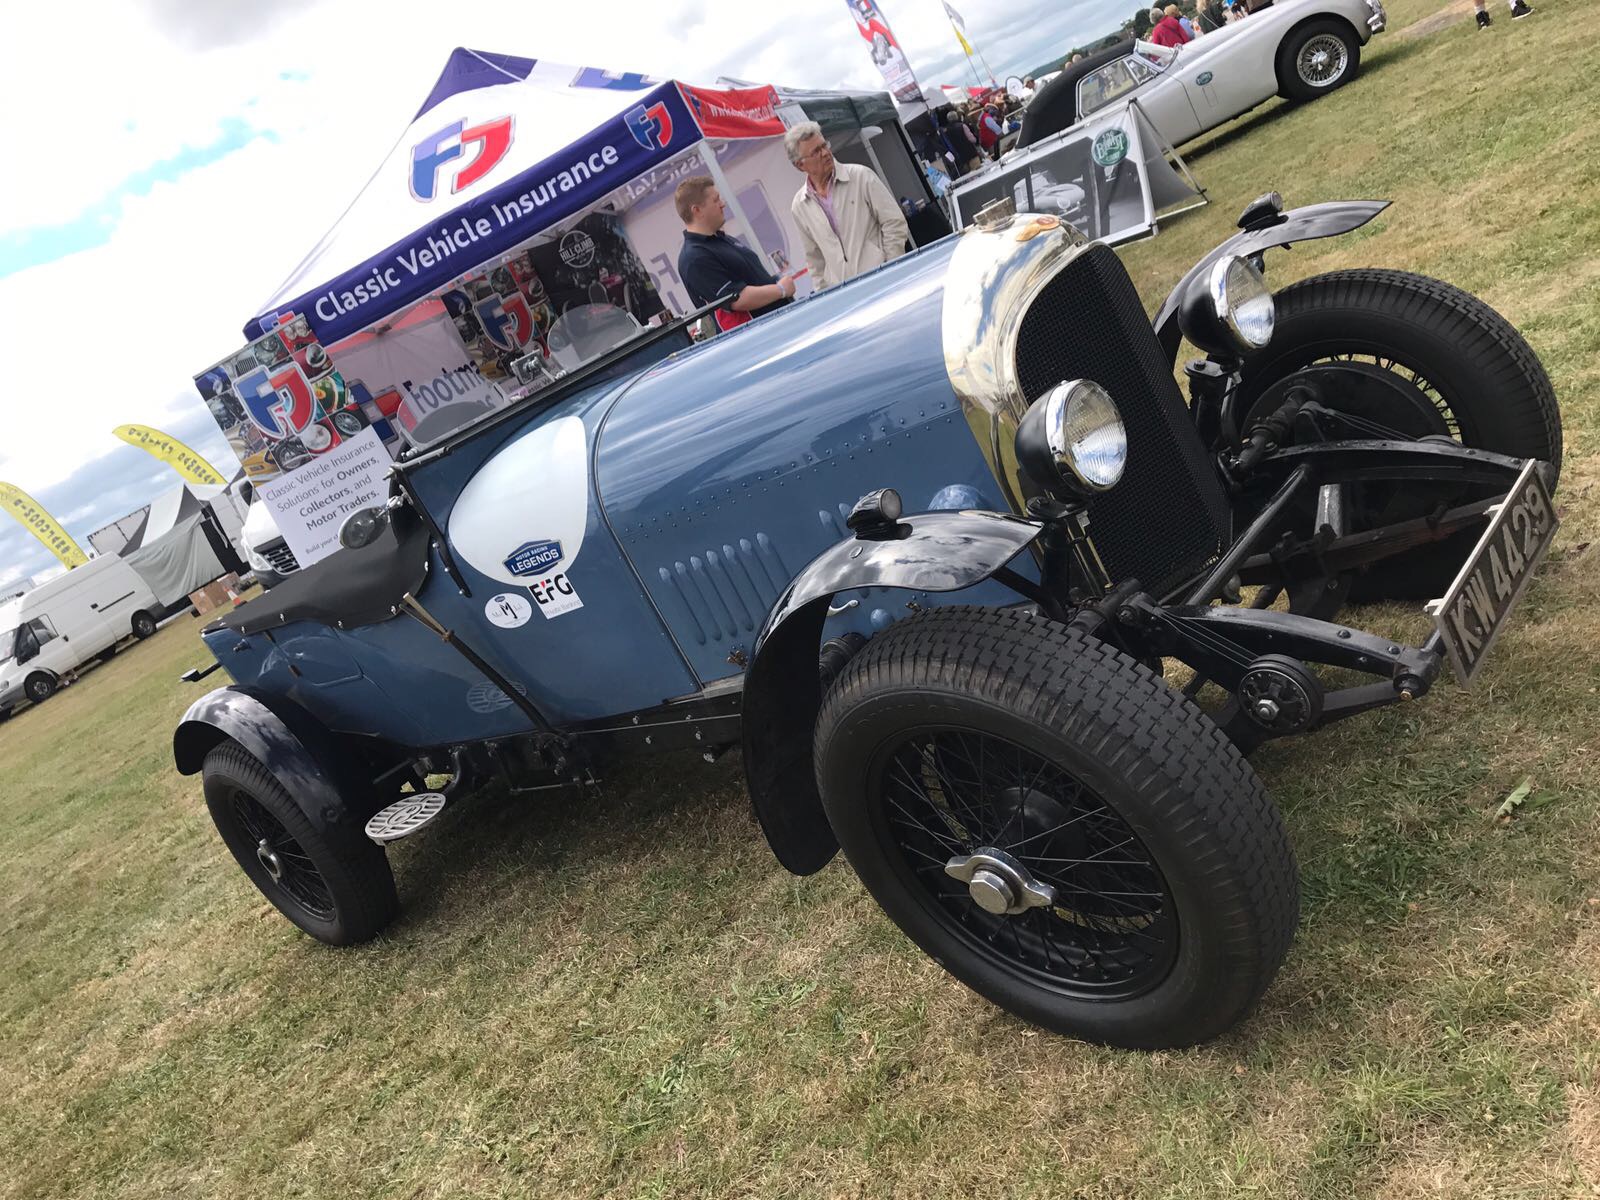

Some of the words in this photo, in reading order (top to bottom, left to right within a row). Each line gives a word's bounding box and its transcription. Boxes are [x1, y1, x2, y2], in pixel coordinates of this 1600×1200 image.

[315, 267, 401, 322] Classic
[397, 217, 492, 276] Vehicle
[491, 145, 619, 227] Insurance
[265, 478, 297, 502] Classic
[295, 463, 331, 485] Vehicle
[330, 440, 376, 467] Insurance
[276, 485, 320, 513] Solutions
[320, 477, 336, 489] for
[336, 455, 380, 481] Owners,
[299, 487, 354, 518] Collectors,
[353, 474, 373, 490] and
[305, 509, 341, 531] Motor
[338, 489, 380, 514] Traders.
[511, 548, 559, 573] LEGENDS
[515, 550, 531, 561] MOTOR
[531, 546, 548, 555] RACING
[1450, 568, 1497, 665] KW
[1488, 484, 1549, 601] 4429
[528, 573, 574, 605] EFG
